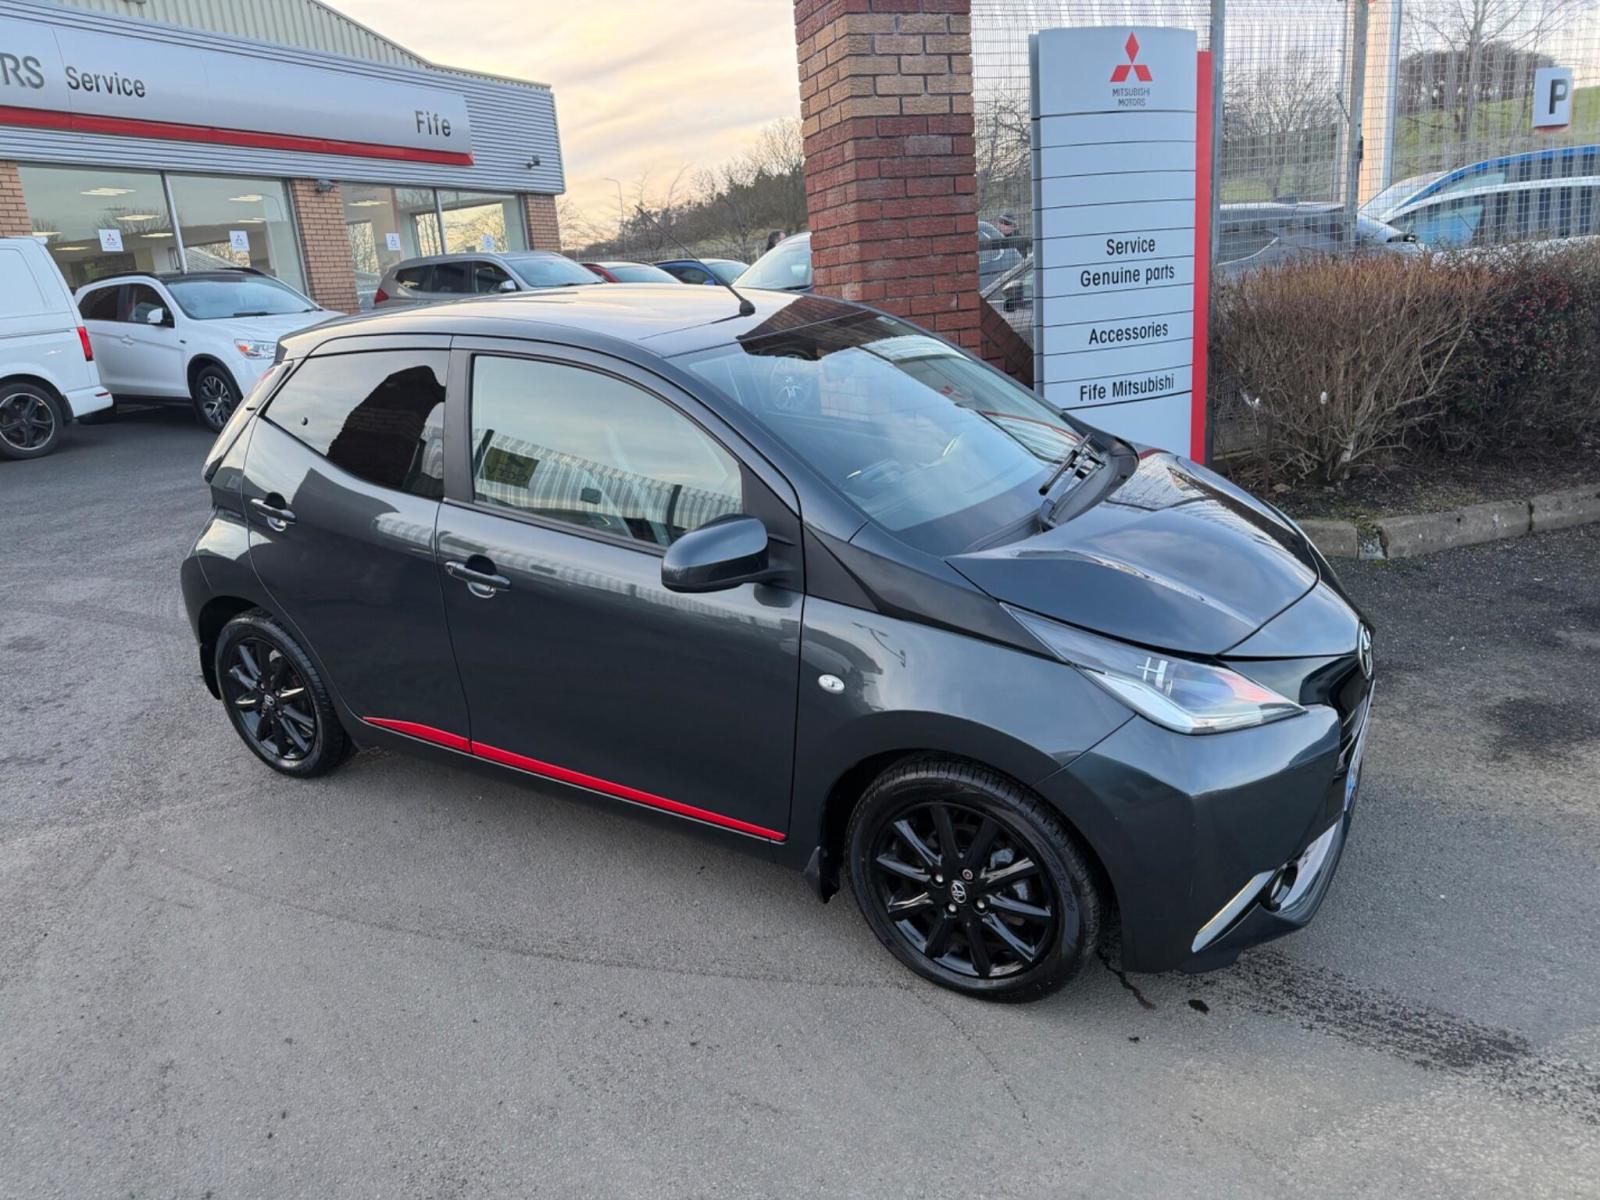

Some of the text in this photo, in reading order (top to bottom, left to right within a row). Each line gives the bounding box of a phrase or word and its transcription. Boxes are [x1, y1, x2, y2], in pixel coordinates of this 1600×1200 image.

[65, 65, 146, 98] Service
[1112, 87, 1151, 97] MITSUBISHI
[1118, 98, 1146, 107] MOTORS
[1549, 79, 1569, 115] P
[415, 110, 452, 137] Fife
[1106, 236, 1156, 256] Service
[1080, 264, 1175, 287] Genuine parts
[1088, 321, 1169, 345] Accessories
[1080, 373, 1175, 401] Fife Mitsubishi
